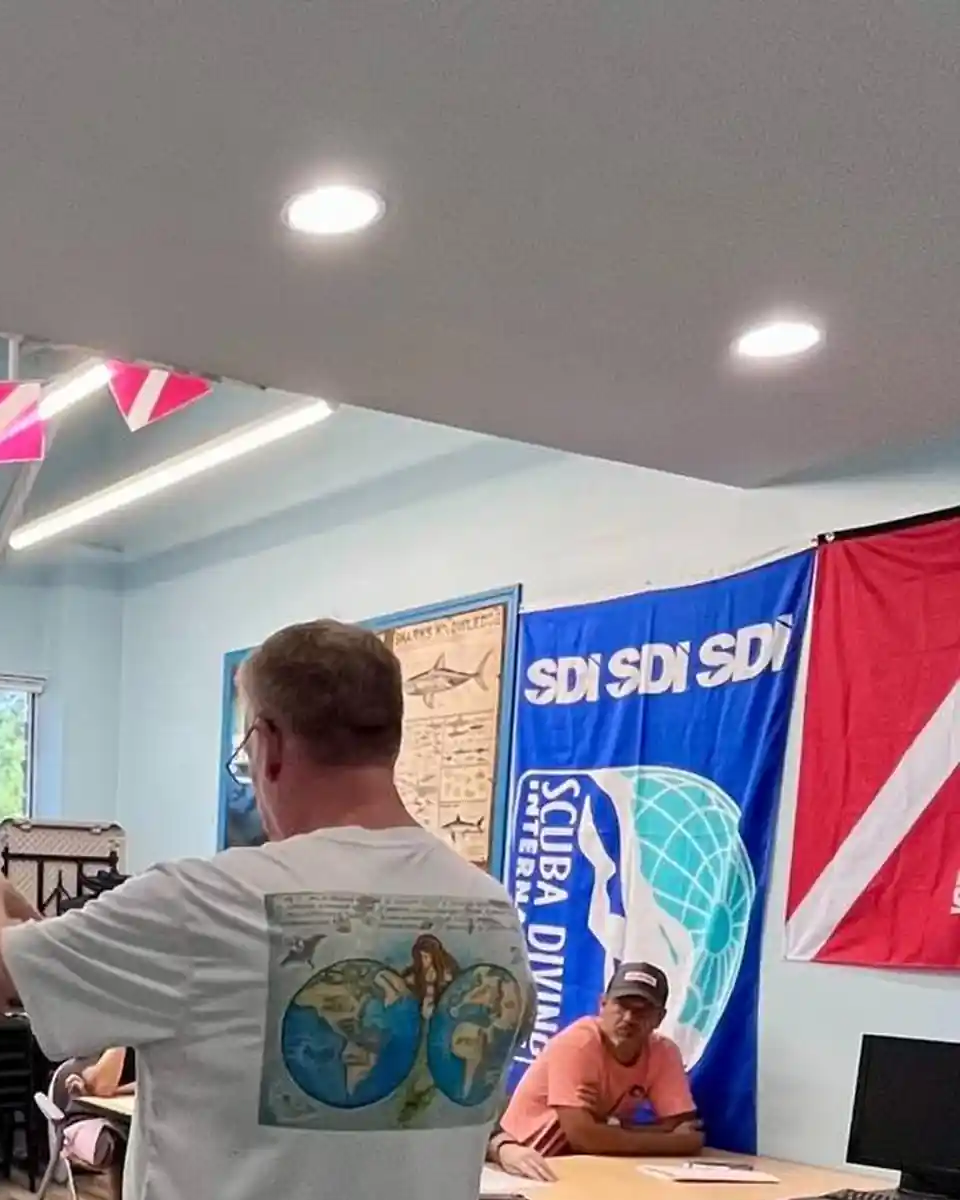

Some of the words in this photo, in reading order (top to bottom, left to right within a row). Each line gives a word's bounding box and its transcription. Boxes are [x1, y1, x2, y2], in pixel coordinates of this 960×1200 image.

[524, 653, 601, 705] SDI
[606, 641, 692, 699] SDI
[696, 614, 792, 688] SDI
[533, 778, 581, 906] SCUBA
